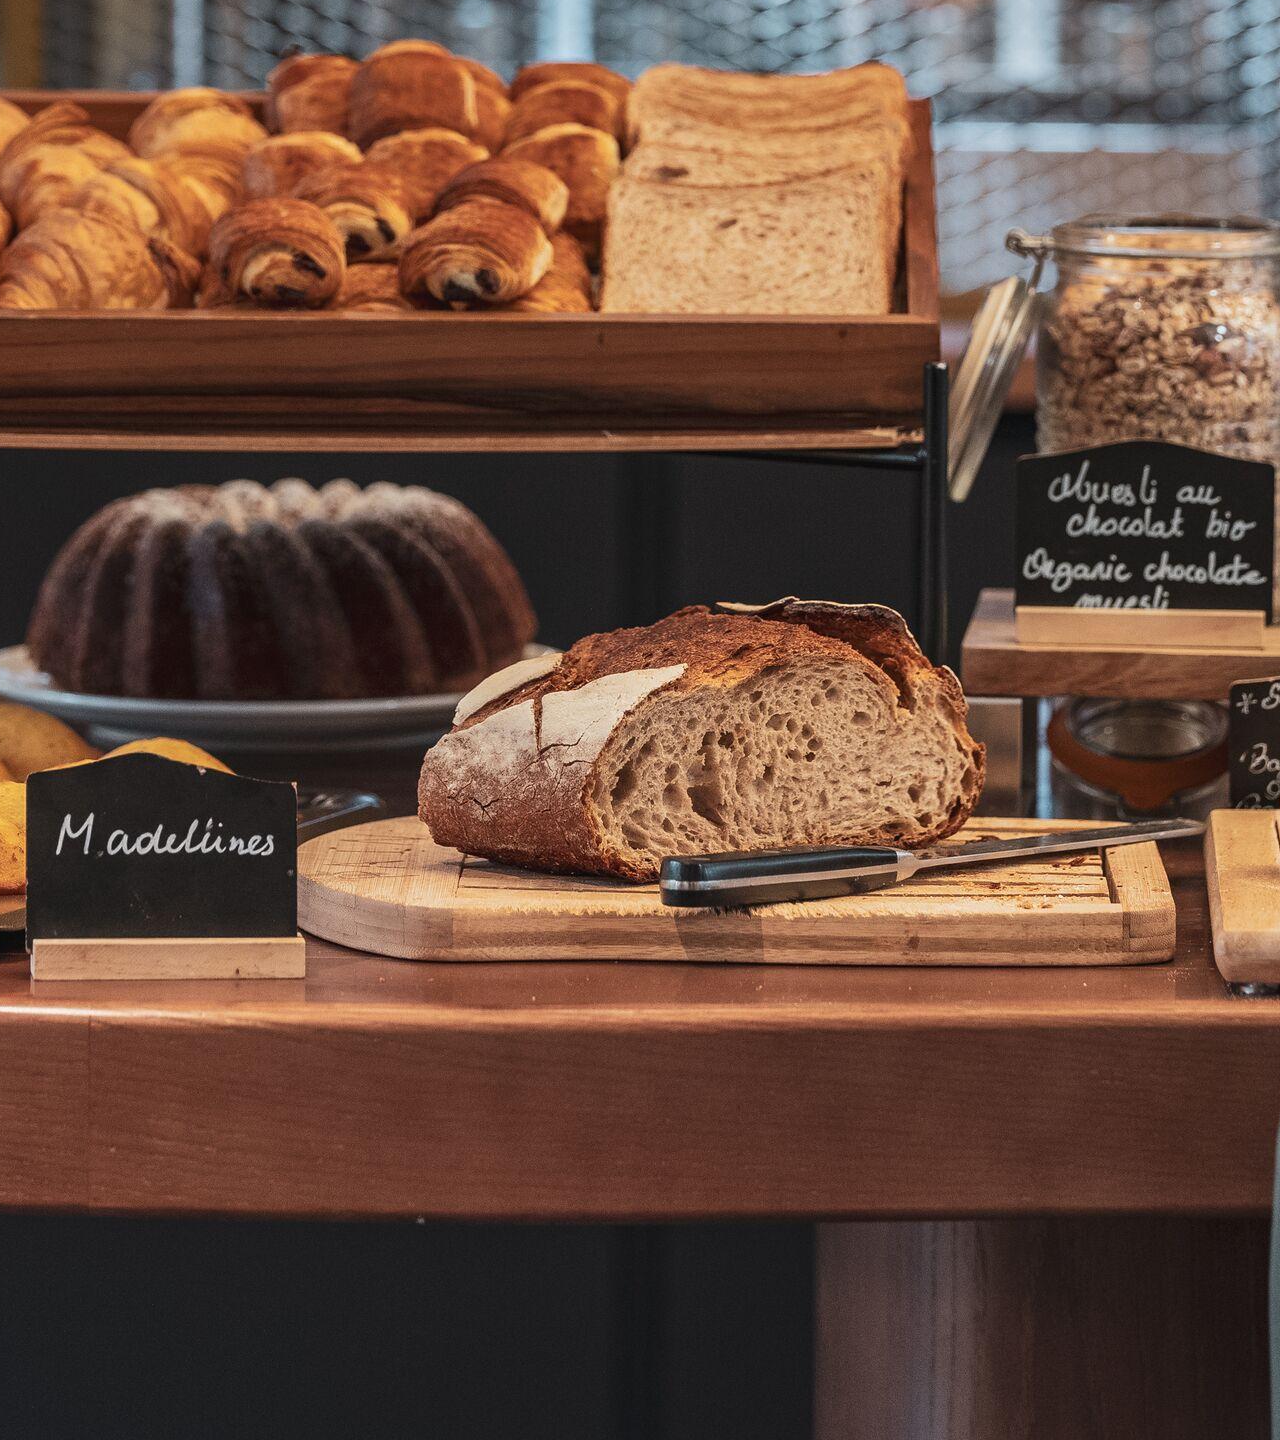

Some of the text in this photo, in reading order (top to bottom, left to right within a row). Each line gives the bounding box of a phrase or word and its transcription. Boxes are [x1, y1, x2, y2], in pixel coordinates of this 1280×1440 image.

[1176, 485, 1222, 505] au
[1066, 504, 1257, 542] chocolat bio
[1023, 547, 1267, 594] Organic chocolate
